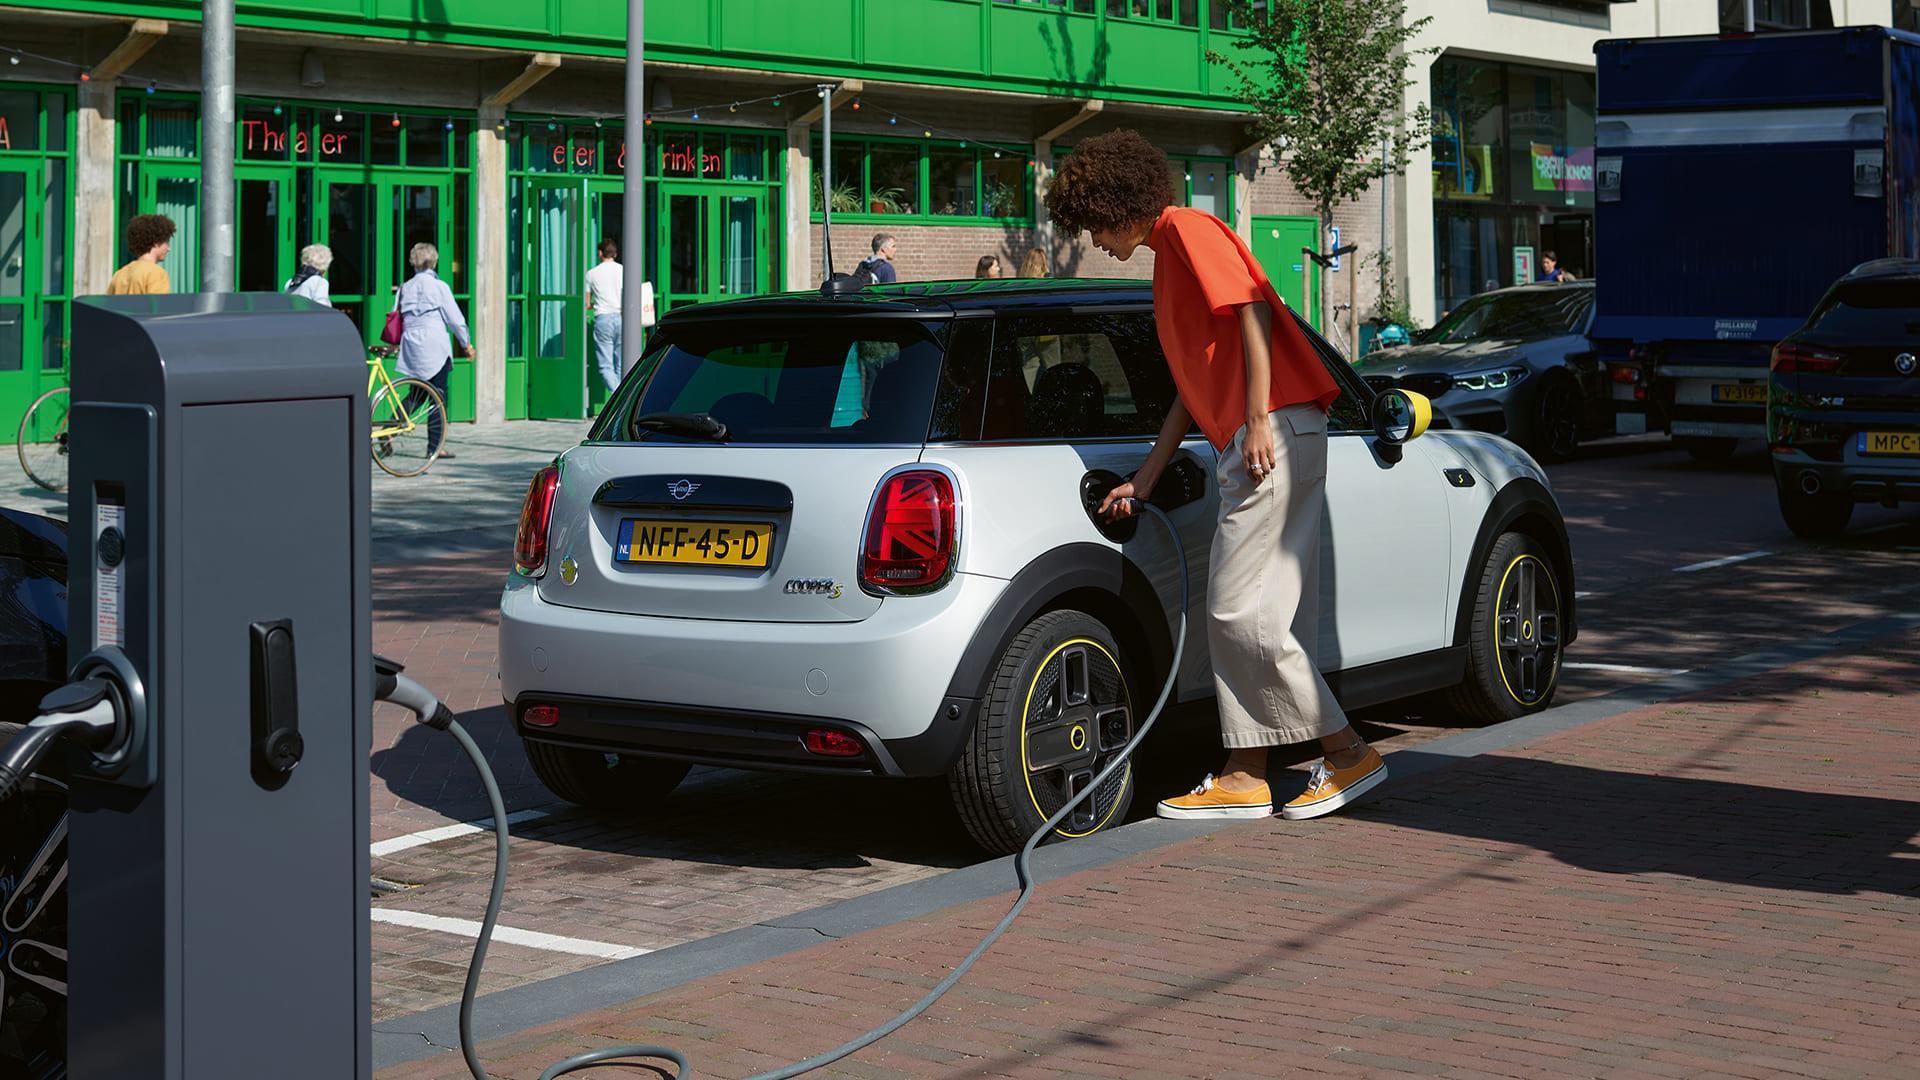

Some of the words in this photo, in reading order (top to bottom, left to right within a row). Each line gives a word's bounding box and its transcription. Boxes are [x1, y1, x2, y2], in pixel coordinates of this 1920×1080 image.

[241, 120, 348, 154] Thaer
[553, 145, 597, 166] ee
[661, 143, 721, 173] rinken
[619, 544, 629, 554] NL
[639, 526, 759, 560] NFF-45-D
[784, 578, 834, 595] COOPER
